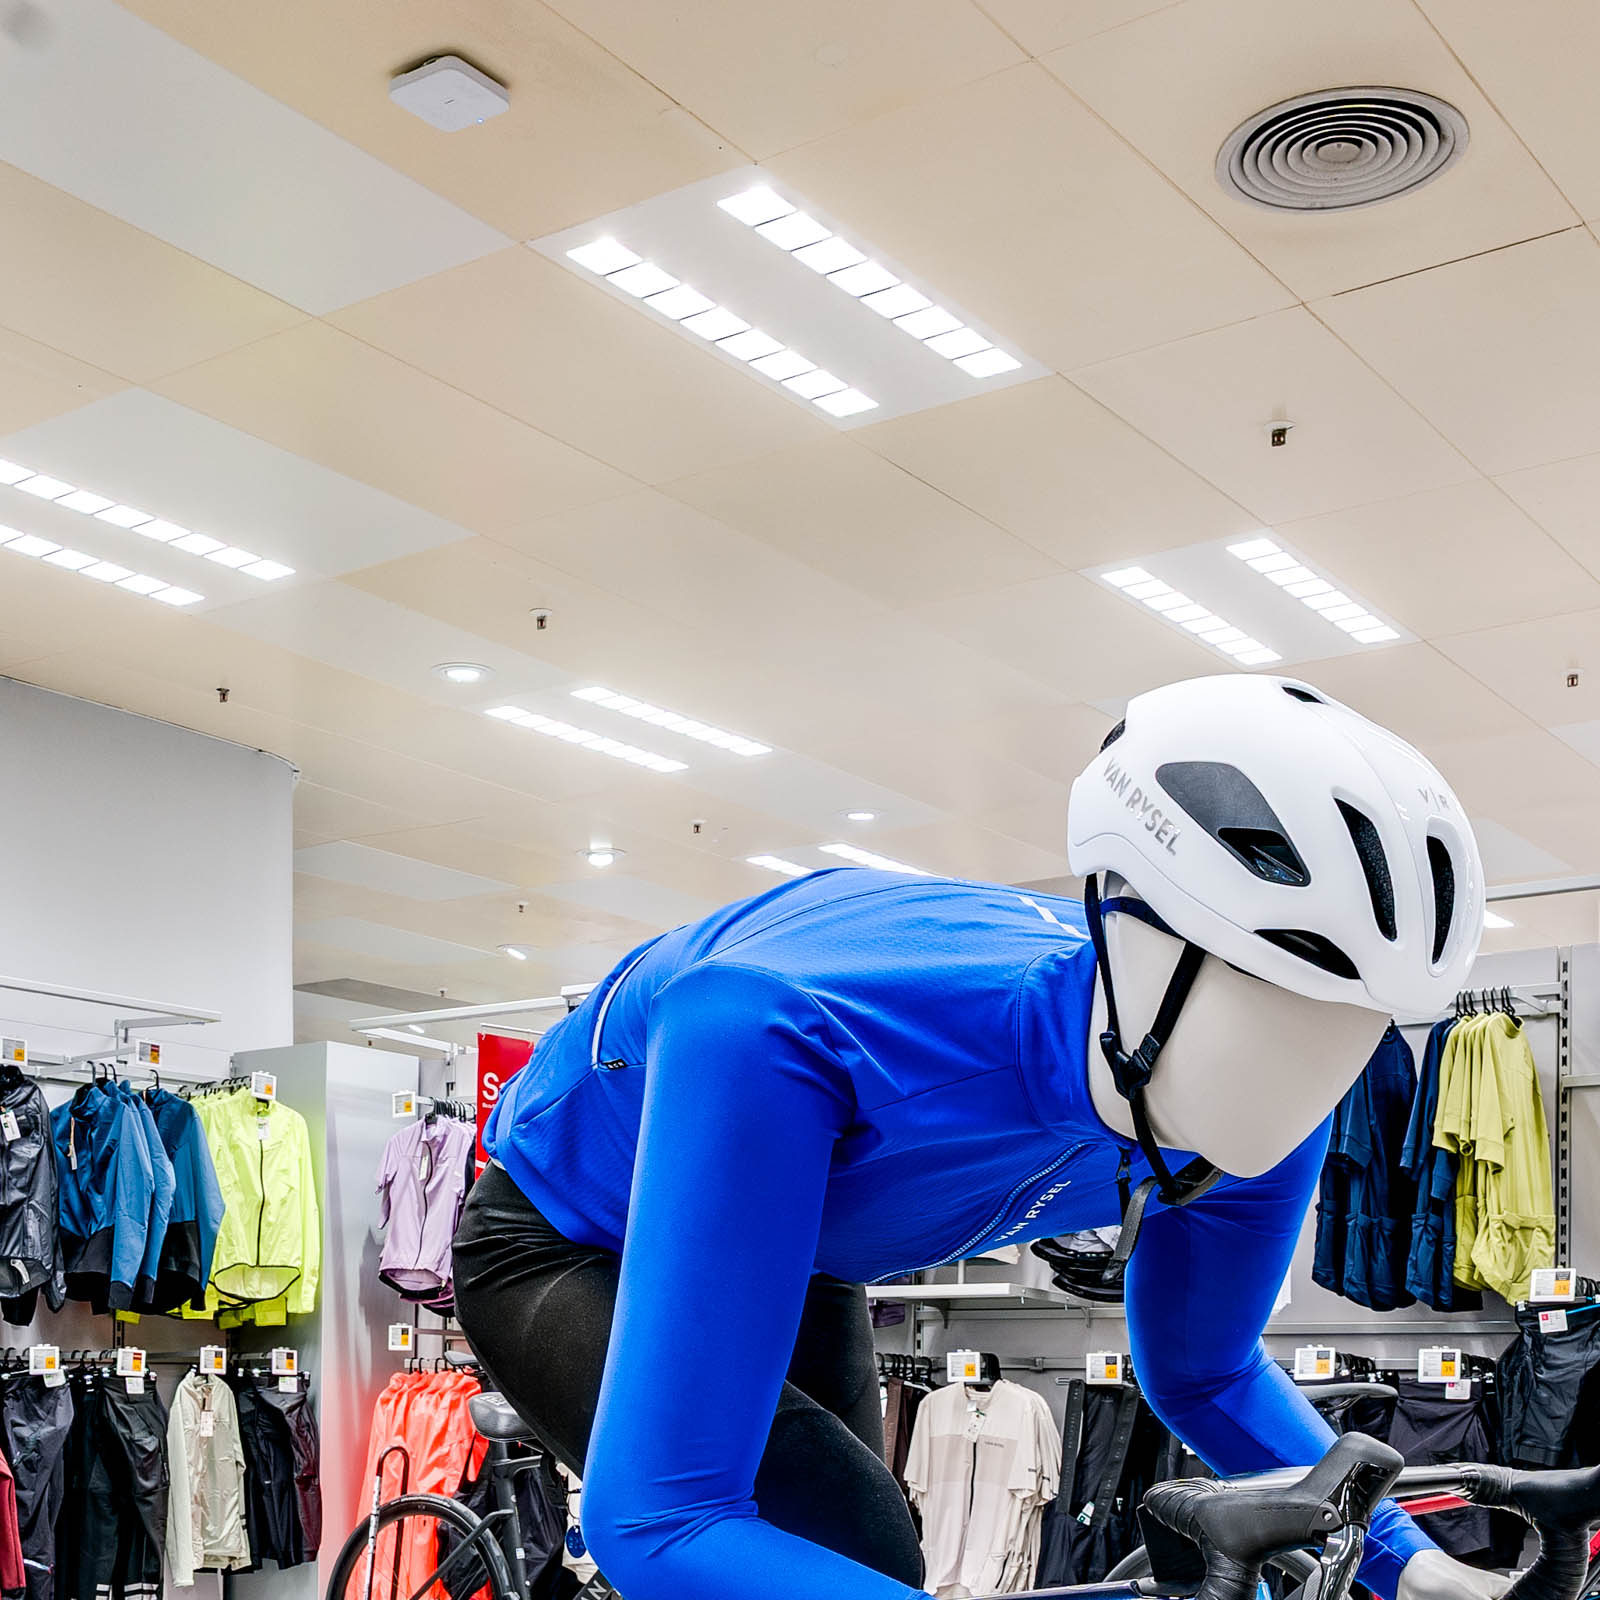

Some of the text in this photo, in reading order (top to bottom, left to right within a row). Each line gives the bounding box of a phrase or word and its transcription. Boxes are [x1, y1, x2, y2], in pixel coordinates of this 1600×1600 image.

[1103, 757, 1182, 856] VAN RYSEL
[995, 1179, 1072, 1243] VAN RYSEL
